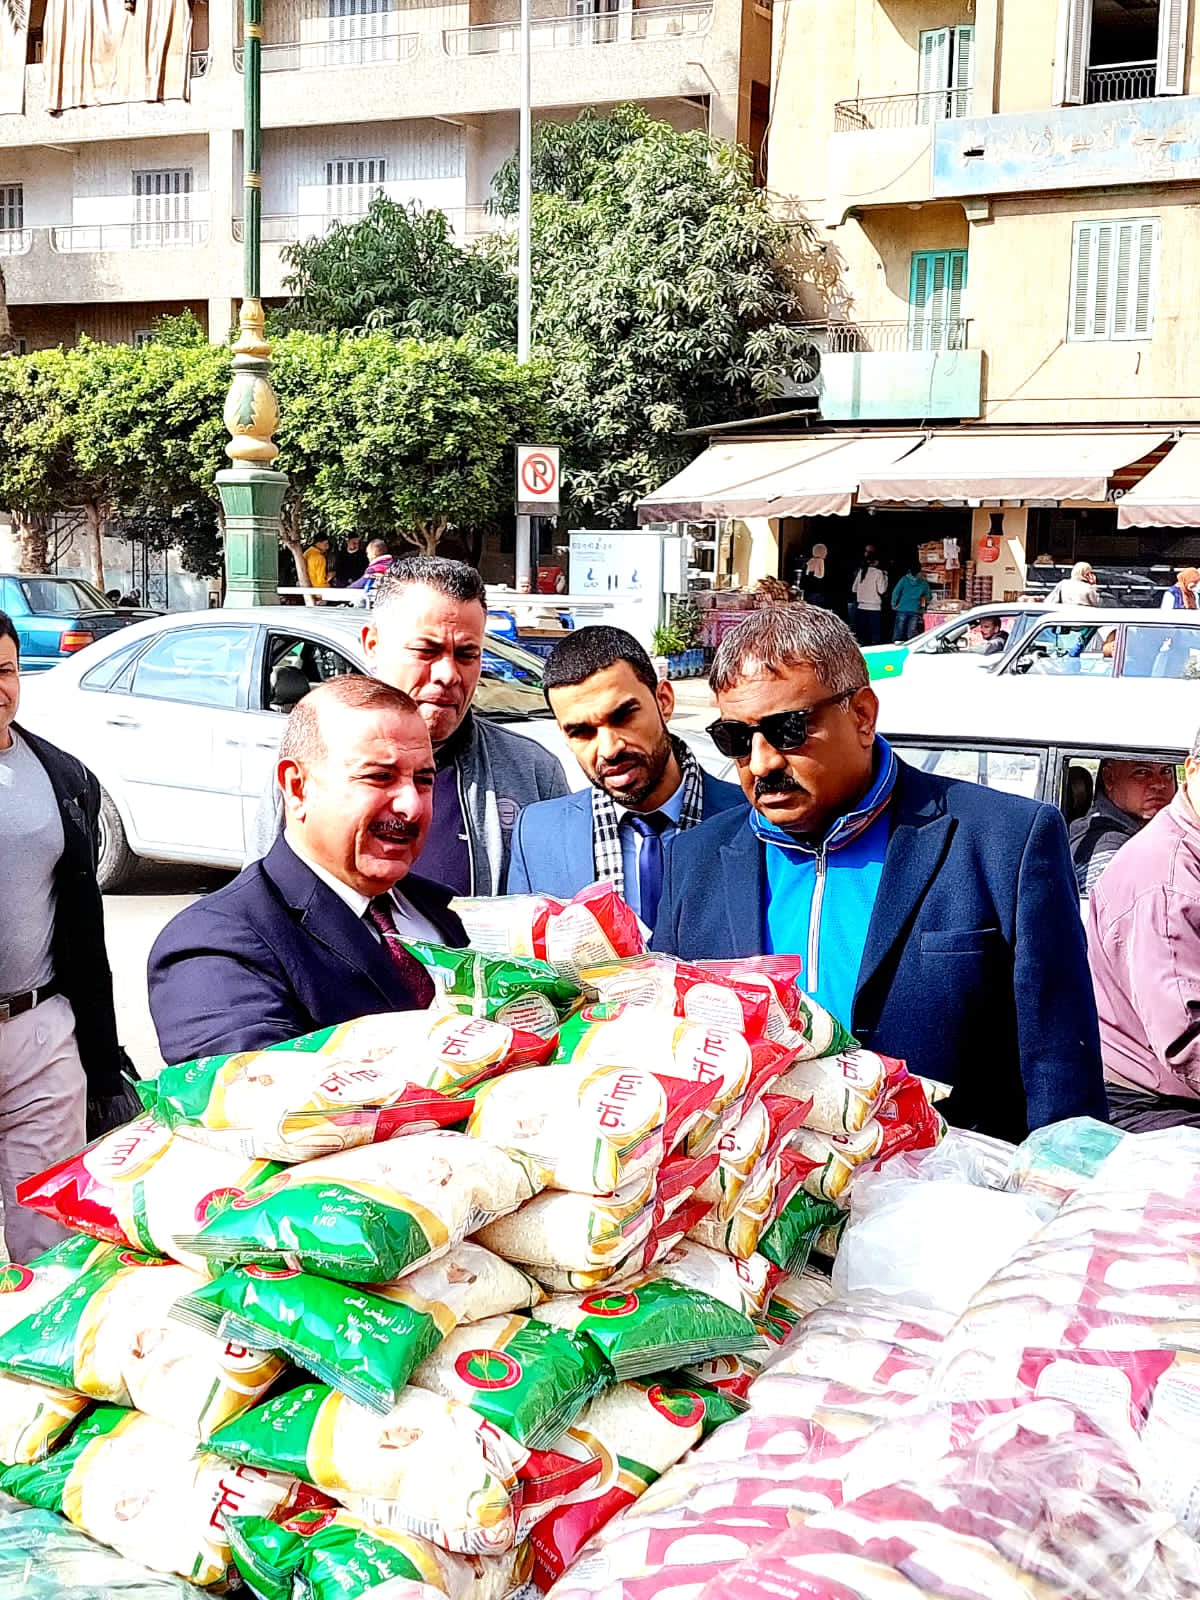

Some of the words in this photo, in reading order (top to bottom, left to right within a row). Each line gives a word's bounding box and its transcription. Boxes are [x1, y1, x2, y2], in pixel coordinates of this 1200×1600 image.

[441, 1035, 470, 1057] خير
[320, 1071, 347, 1096] خير
[603, 1074, 644, 1101] بلدنا
[596, 1100, 626, 1128] خير
[312, 1215, 319, 1225] 1
[320, 1216, 337, 1227] KG
[335, 1323, 344, 1335] 1
[342, 1327, 363, 1346] KG
